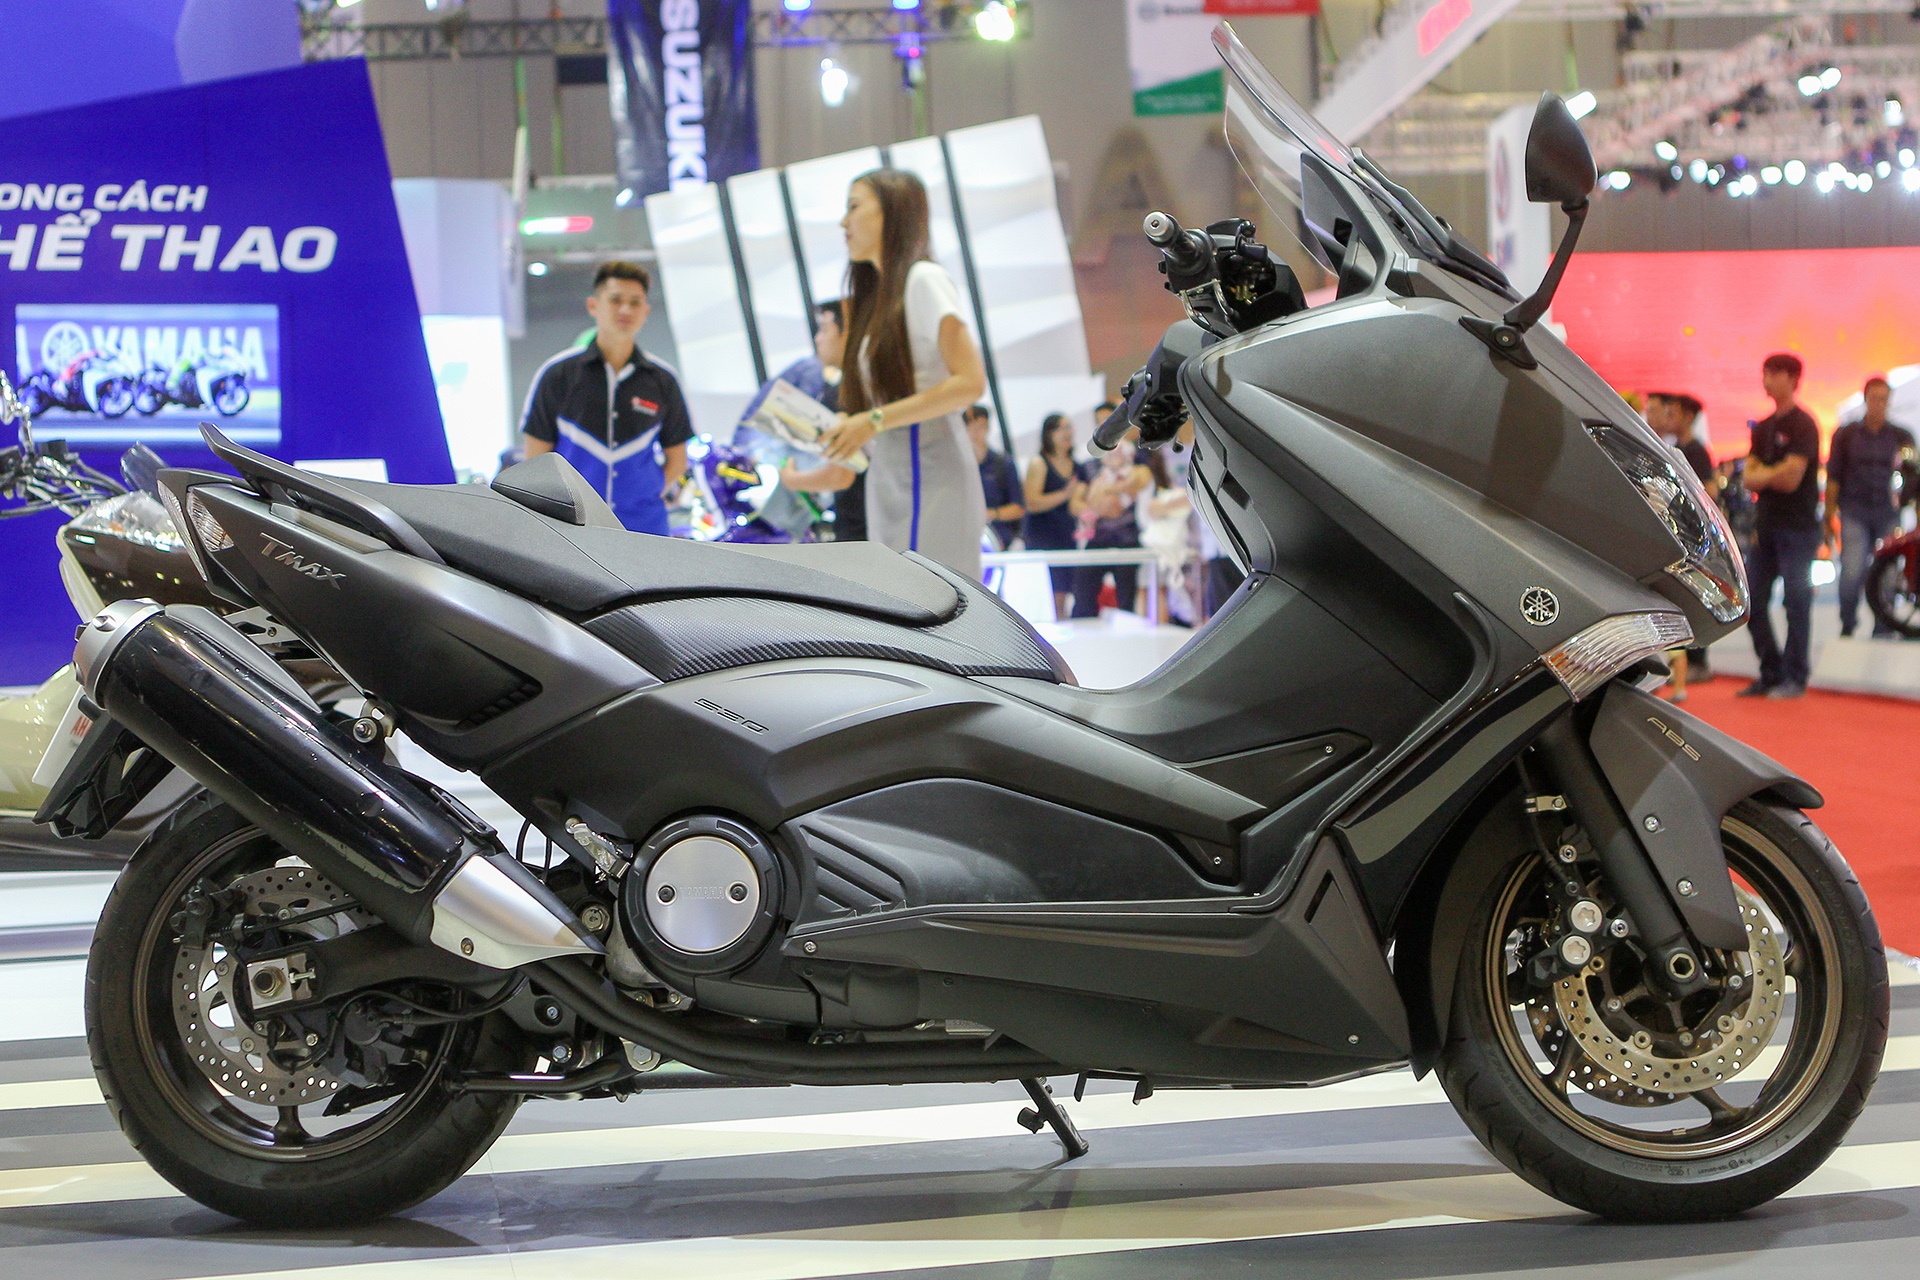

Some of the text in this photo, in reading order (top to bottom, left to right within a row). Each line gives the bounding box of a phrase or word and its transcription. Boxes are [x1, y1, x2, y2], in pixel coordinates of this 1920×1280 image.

[659, 0, 708, 192] SUZUKI
[0, 179, 209, 212] ONG CÁCH
[111, 224, 338, 273] THAO
[92, 326, 268, 381] YAMAHA
[694, 697, 770, 735] 530
[1647, 717, 1702, 761] ABS
